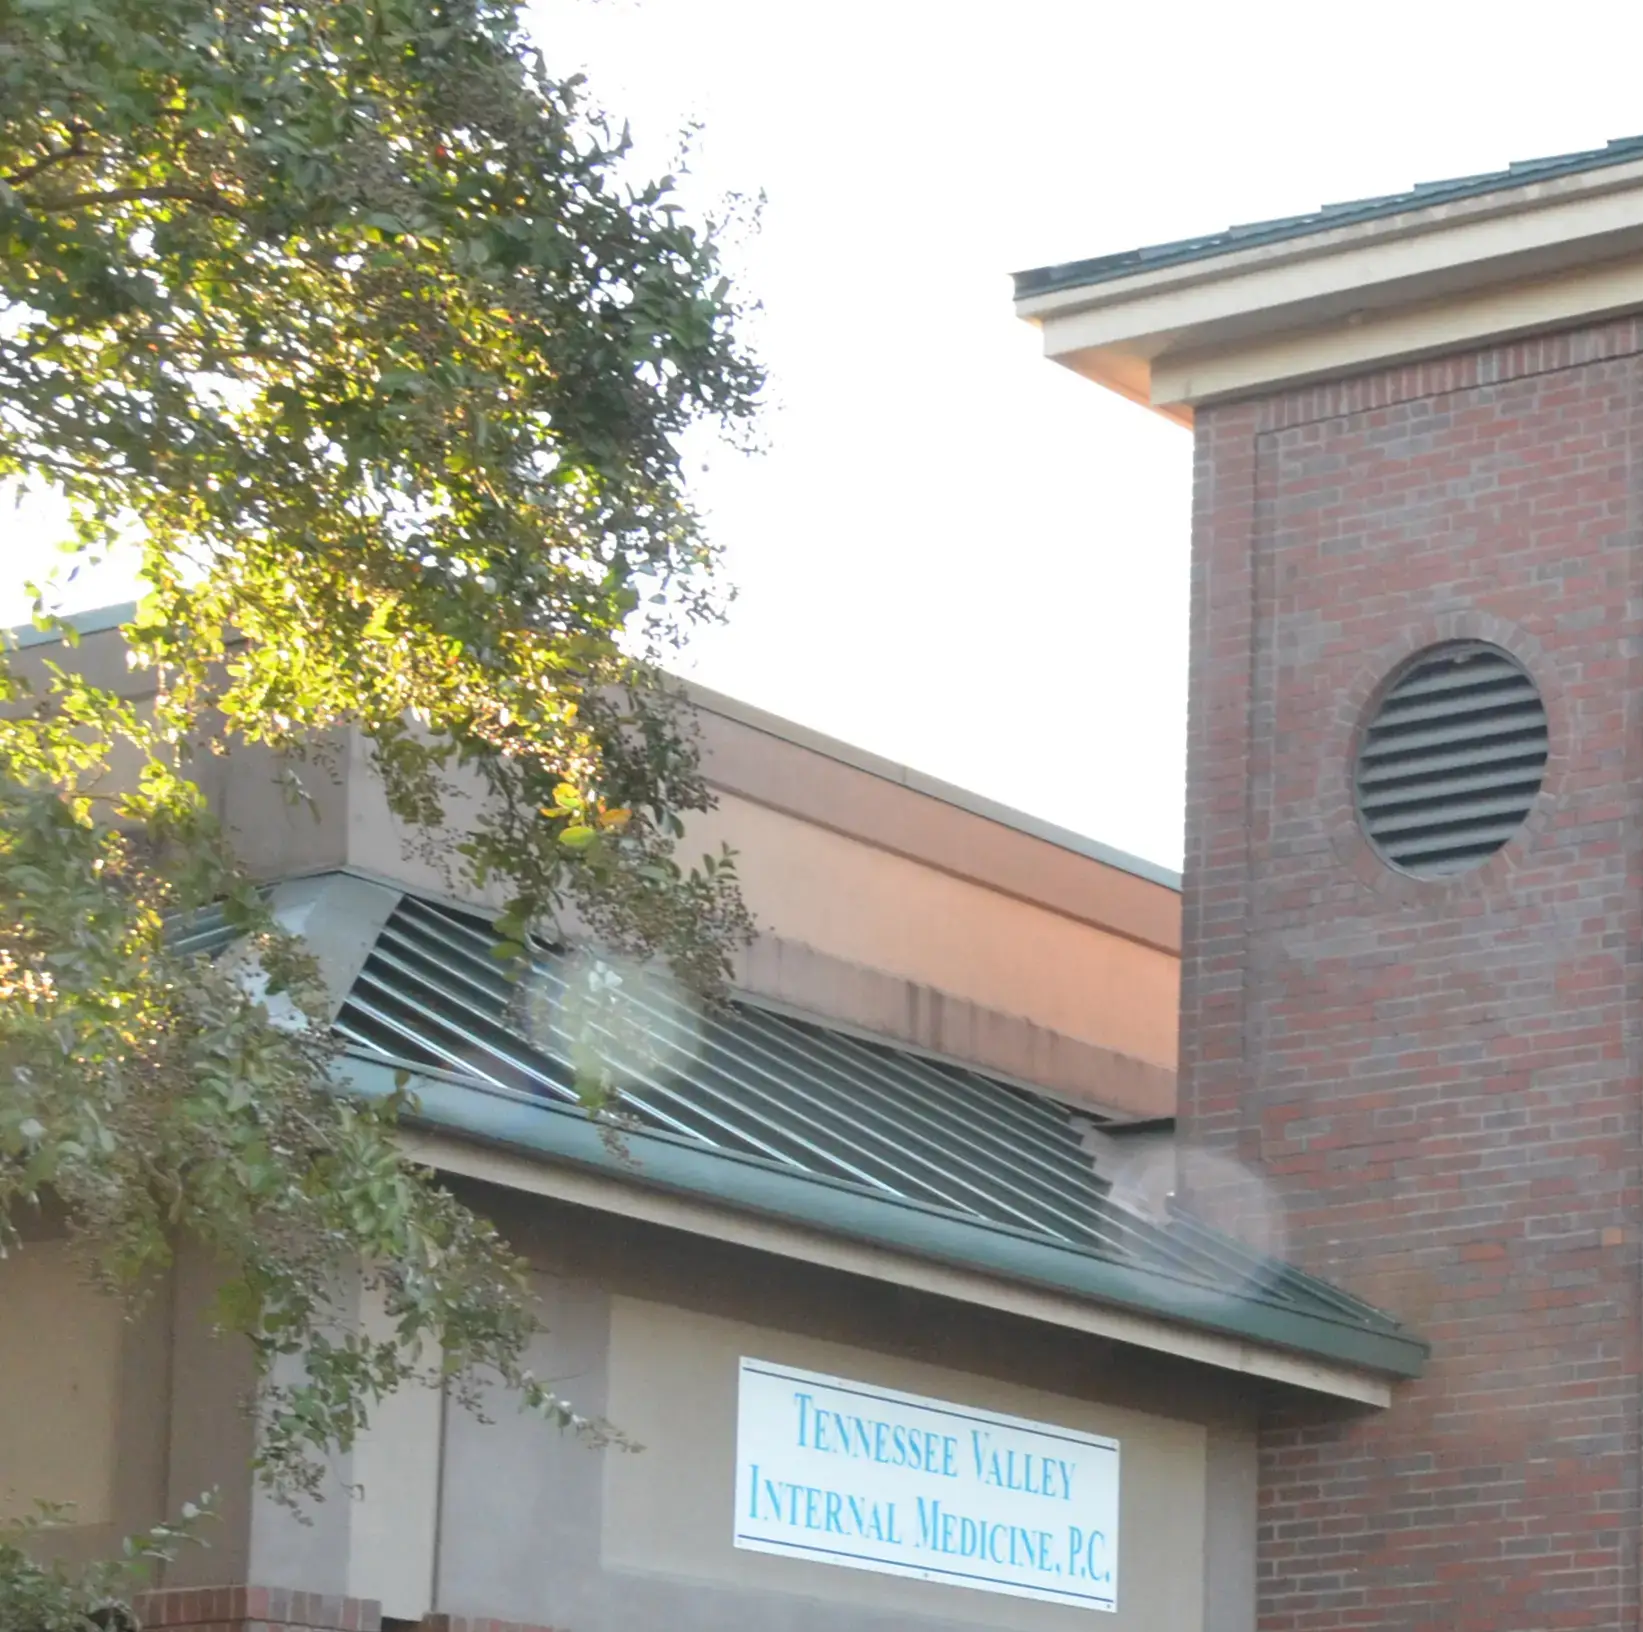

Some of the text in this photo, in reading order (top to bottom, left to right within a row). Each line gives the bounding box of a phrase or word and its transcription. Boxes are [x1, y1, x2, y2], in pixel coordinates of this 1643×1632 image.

[793, 1392, 1076, 1501] TENNESSEE VALLEY
[748, 1464, 902, 1545] INTERNAL
[1067, 1525, 1111, 1583] P.C.
